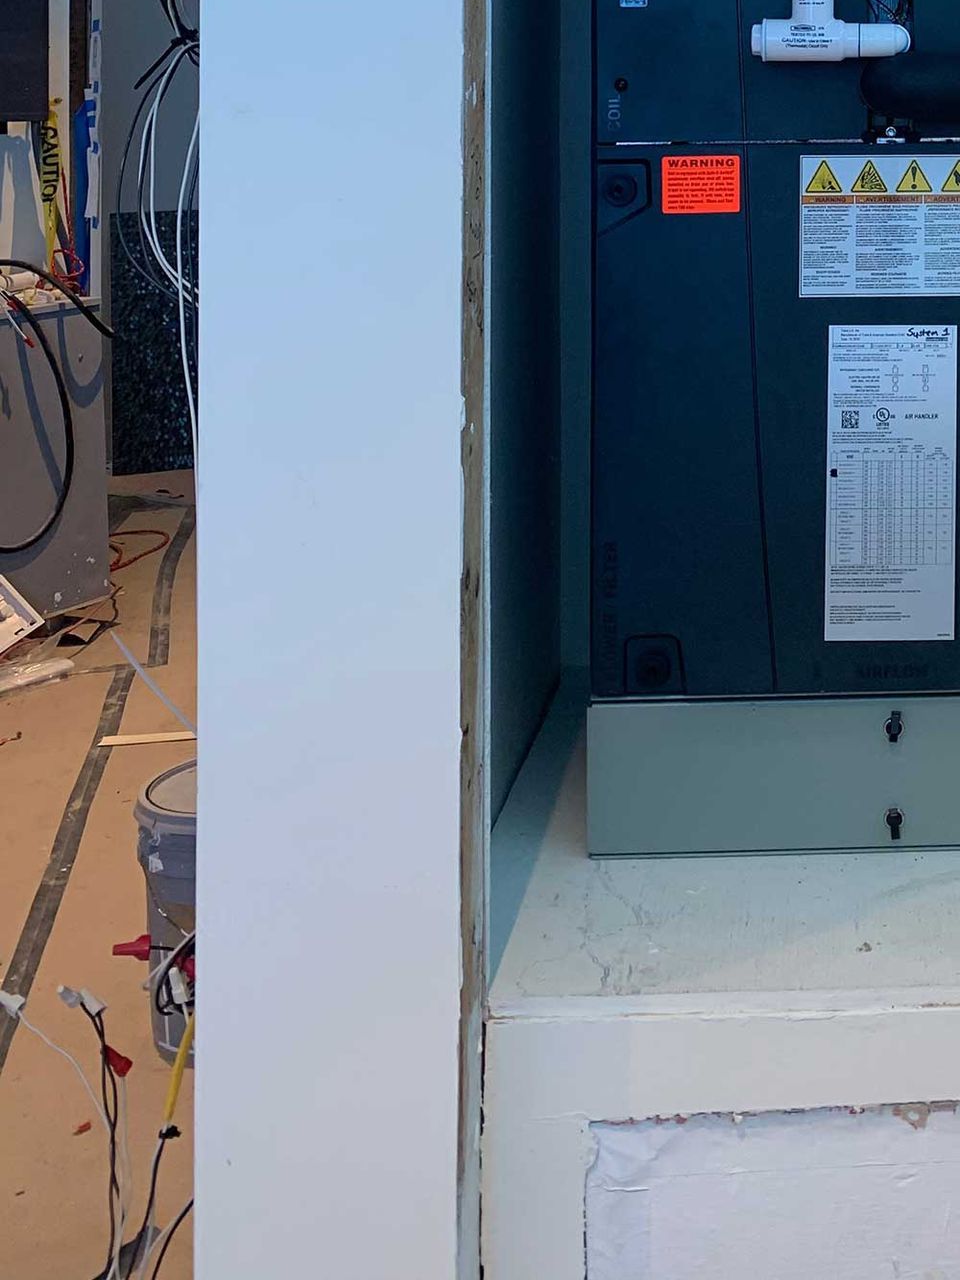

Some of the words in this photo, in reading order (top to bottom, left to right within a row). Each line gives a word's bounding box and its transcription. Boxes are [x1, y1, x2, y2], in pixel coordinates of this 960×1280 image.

[668, 159, 735, 167] WARNING
[907, 327, 938, 338] System
[941, 327, 950, 336] 1
